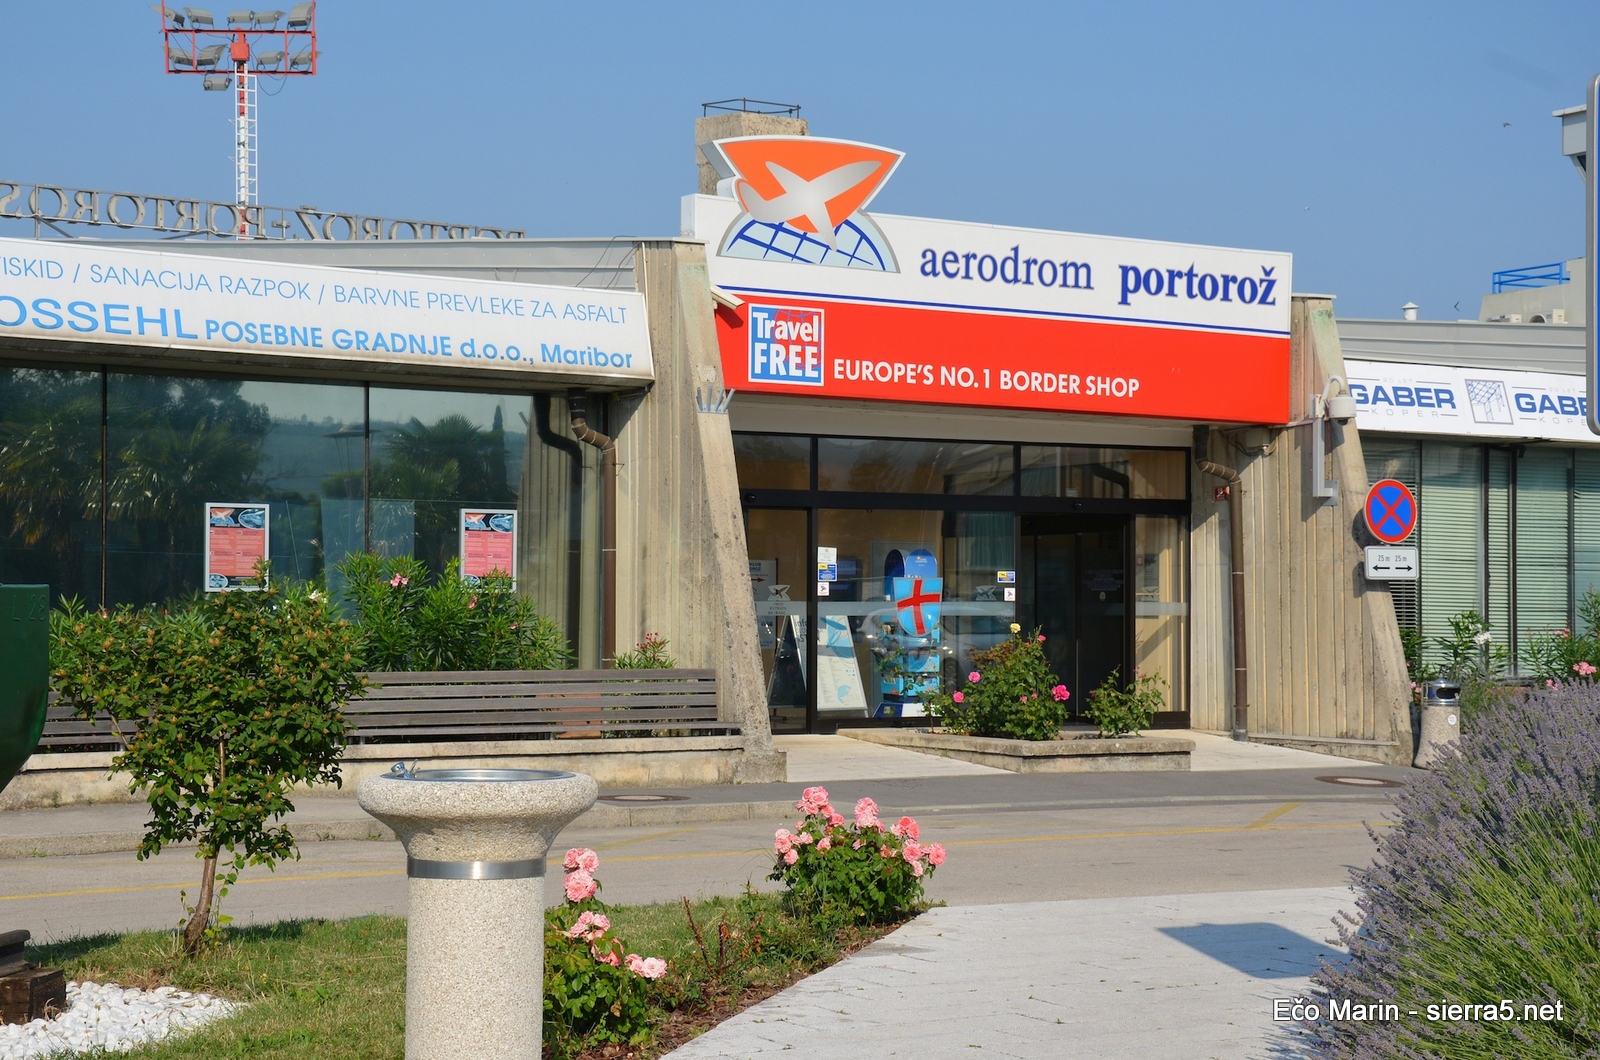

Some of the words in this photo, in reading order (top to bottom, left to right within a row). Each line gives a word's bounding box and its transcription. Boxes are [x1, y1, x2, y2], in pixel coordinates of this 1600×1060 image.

[0, 256, 64, 279] ISKID
[90, 263, 212, 292] SANACIJA
[220, 275, 312, 300] RAZPOK
[334, 285, 421, 309] BARVNE
[427, 292, 524, 317] PREVLEKE
[530, 300, 557, 319] ZA
[562, 303, 627, 324] ASFALT
[919, 244, 1095, 290] aerodrom
[1118, 261, 1278, 306] portorož
[205, 319, 323, 348] POSEBNE
[332, 328, 453, 356] GRADNJE
[460, 338, 534, 365] d.o.o.,
[541, 343, 633, 369] Maribor
[753, 311, 819, 342] Travel
[754, 342, 819, 378] FREE
[834, 358, 934, 386] EUROPE'S
[1000, 369, 1081, 395] BORDER
[1085, 375, 1140, 398] SHOP
[1348, 384, 1457, 409] GABER
[1371, 408, 1439, 418] KOPER
